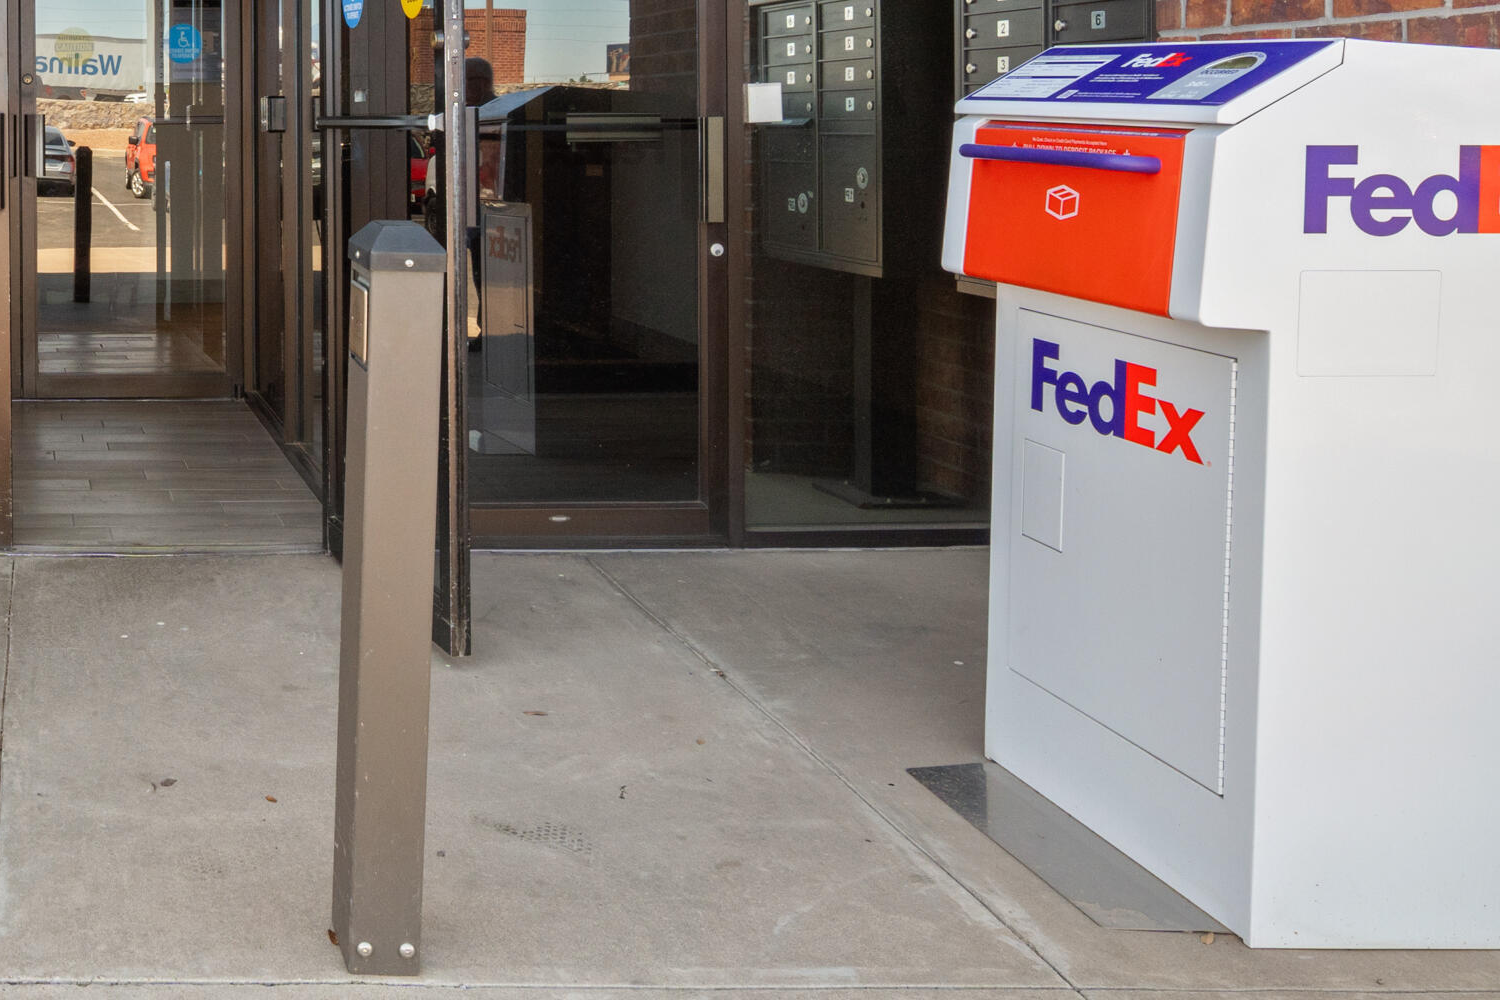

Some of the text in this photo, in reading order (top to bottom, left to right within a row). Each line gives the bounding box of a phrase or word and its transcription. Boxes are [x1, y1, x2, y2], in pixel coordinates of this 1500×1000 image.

[1094, 13, 1102, 26] 6
[1120, 52, 1193, 68] FedEx
[1031, 337, 1205, 467] FedEx
